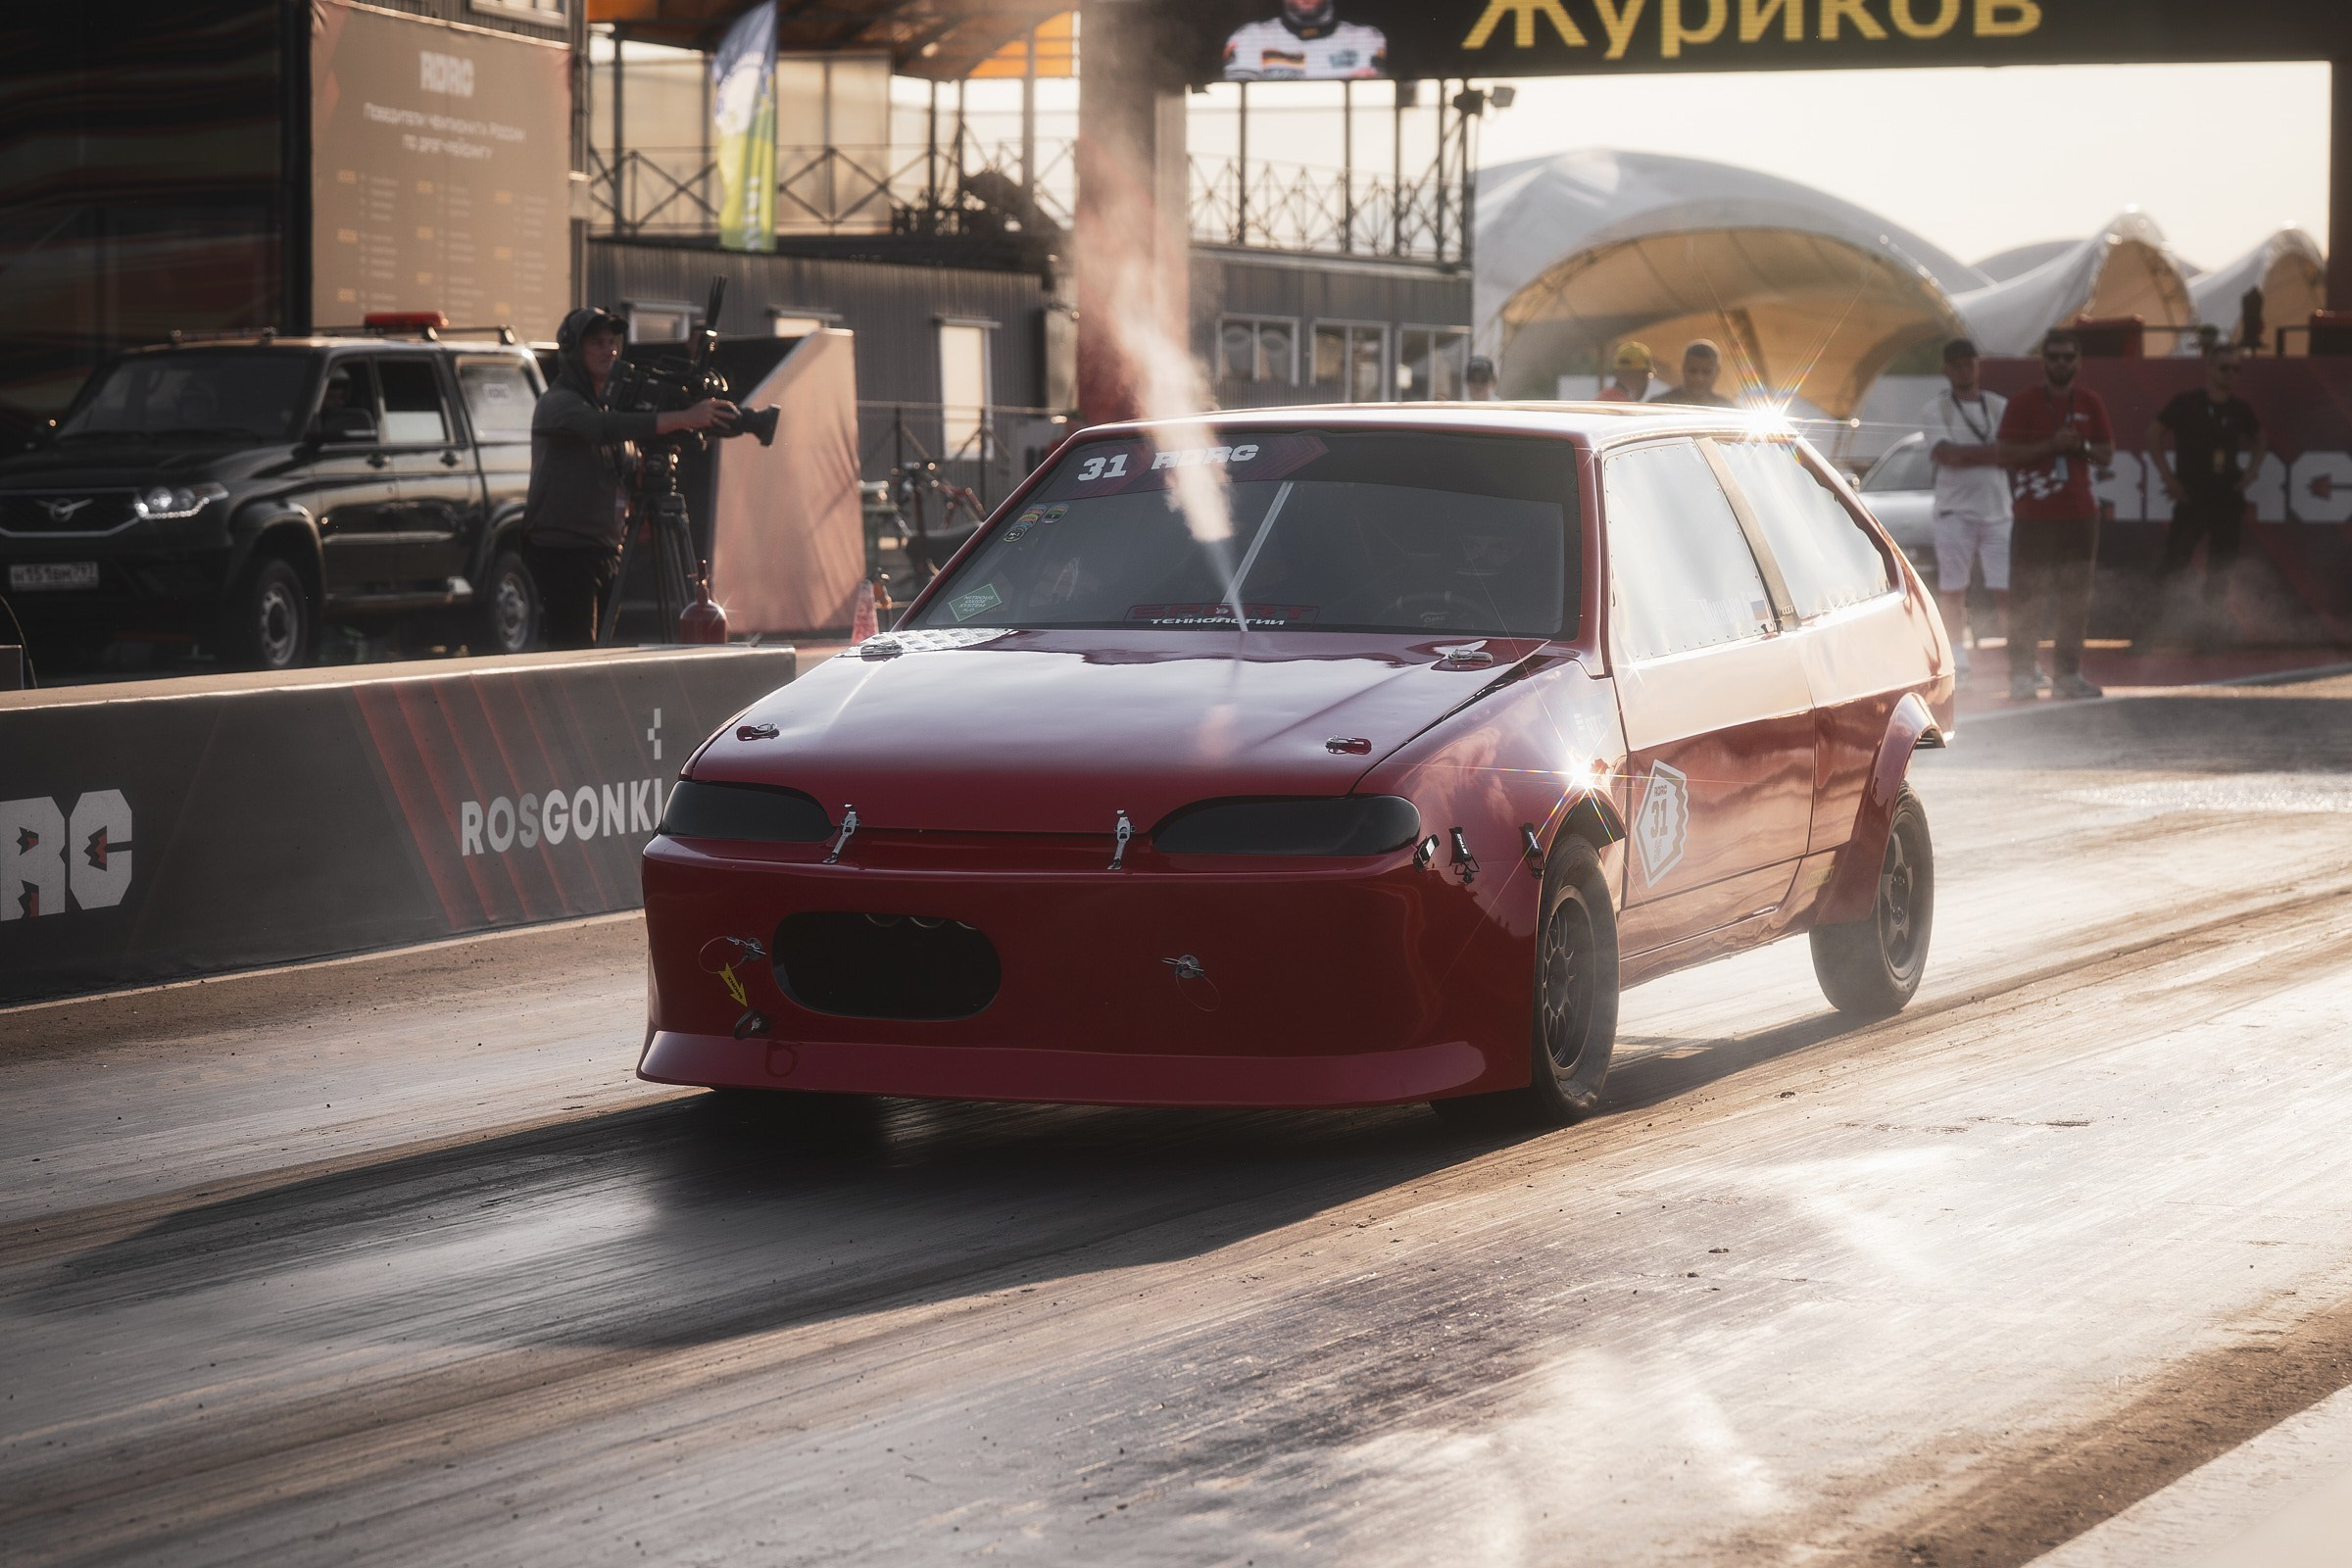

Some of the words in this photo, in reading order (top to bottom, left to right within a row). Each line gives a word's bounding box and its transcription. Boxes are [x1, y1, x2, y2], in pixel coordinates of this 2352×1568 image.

[1460, 0, 2042, 60] Журиков
[1077, 453, 1129, 481] 31
[1151, 444, 1260, 470] RDRC
[1131, 605, 1312, 619] SPORT
[462, 778, 662, 857] ROSGONKI
[1651, 799, 1668, 838] 31
